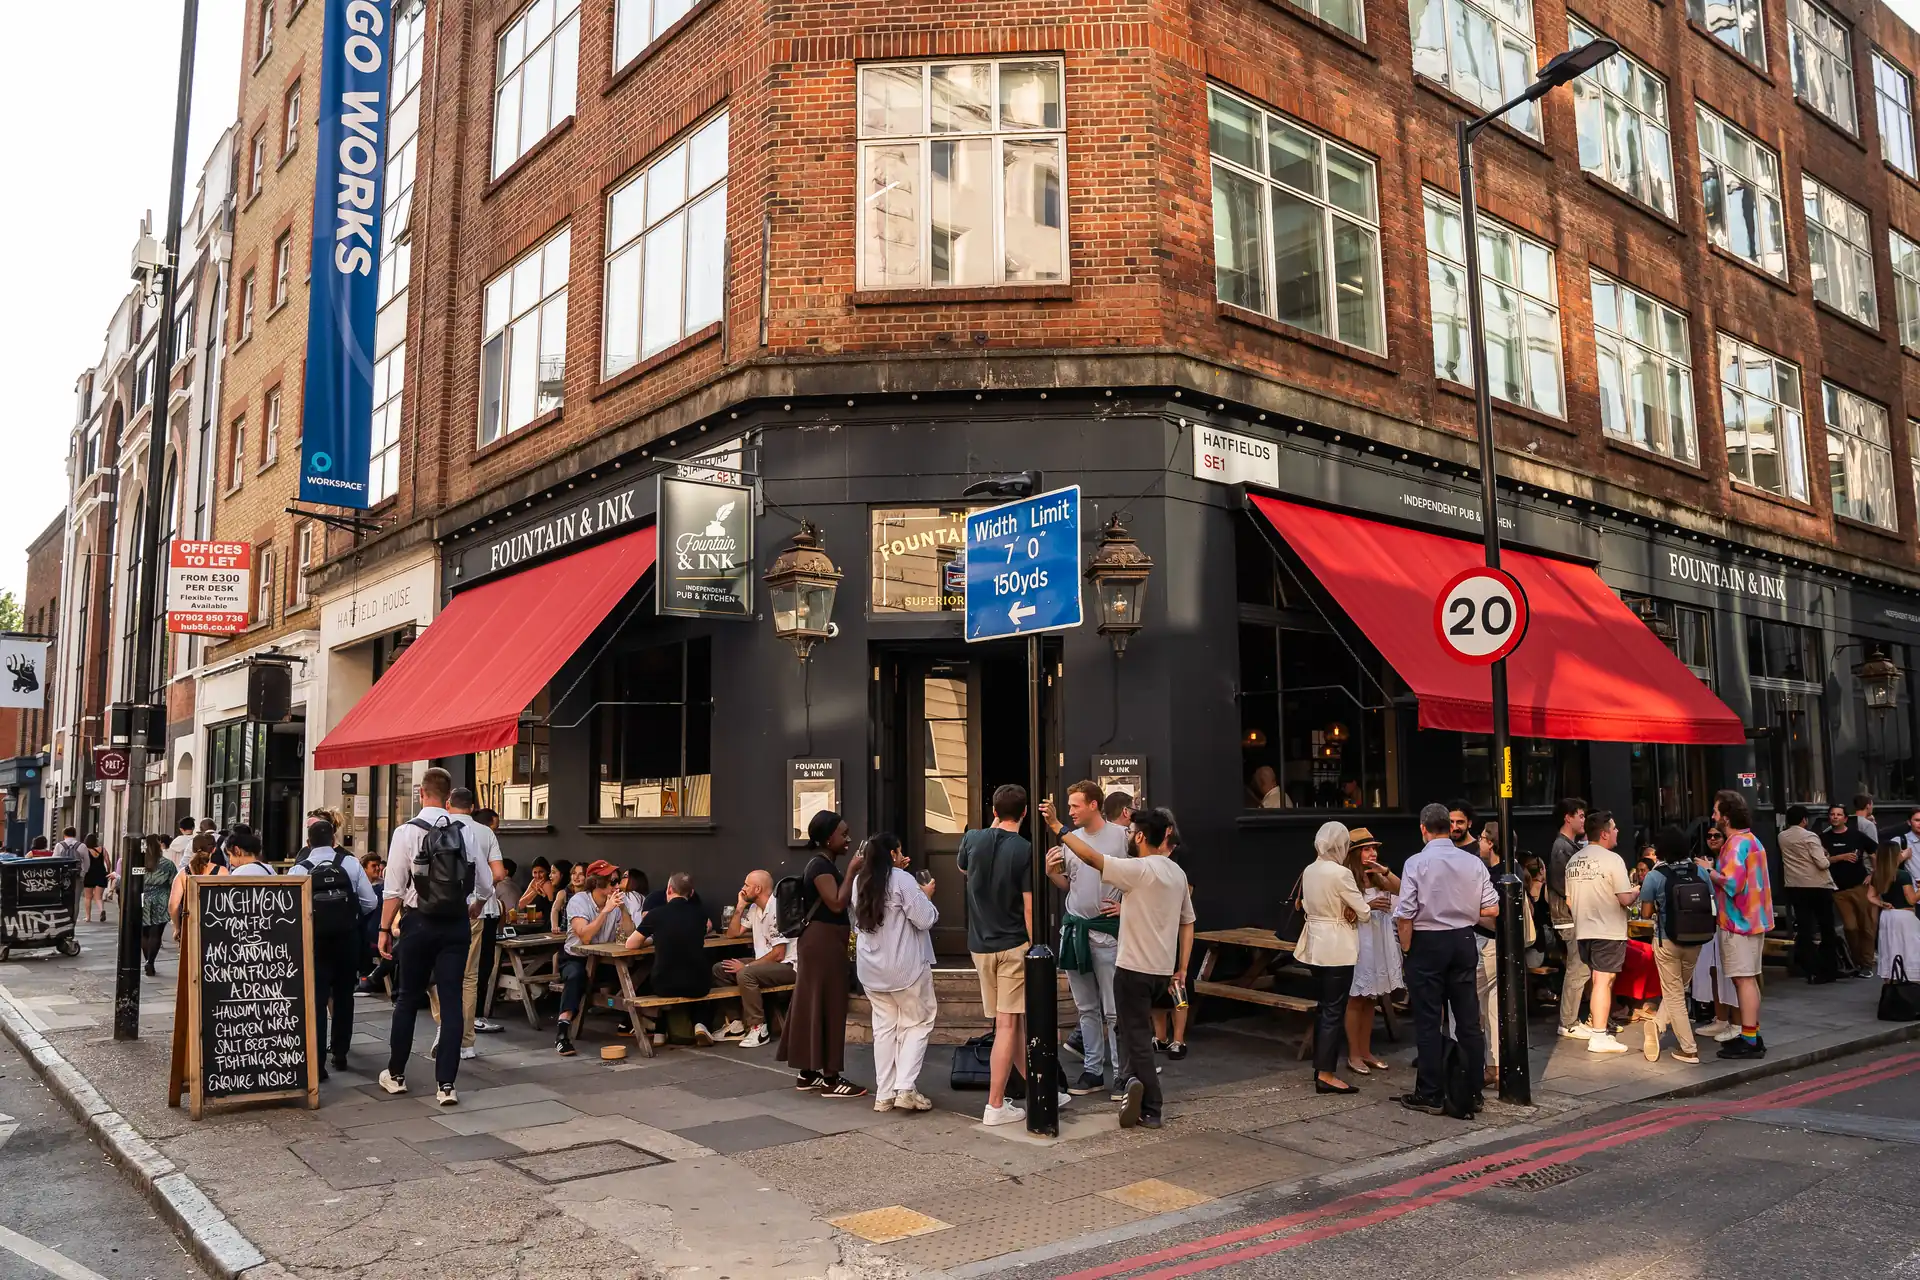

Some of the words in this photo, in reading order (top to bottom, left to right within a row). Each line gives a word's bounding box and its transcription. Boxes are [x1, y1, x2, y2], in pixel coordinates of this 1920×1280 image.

[344, 0, 384, 73] GO
[335, 91, 380, 277] WORKS
[1203, 432, 1270, 460] HATFIELDS
[1204, 454, 1225, 471] SE1
[307, 476, 363, 491] WORKSPACE
[950, 512, 967, 523] TH
[1403, 494, 1458, 517] INDEPENDENT
[1459, 507, 1475, 520] PUB
[1475, 511, 1481, 522] &
[491, 513, 576, 571] FOUNTAIN
[580, 507, 593, 537] &
[597, 489, 635, 531] INK
[974, 516, 1018, 542] Width
[1031, 498, 1070, 528] Limit
[180, 543, 243, 555] OFFICES
[676, 532, 736, 556] Fountain
[880, 527, 967, 561] FOUNTAI
[185, 555, 205, 566] TO
[209, 556, 237, 567] LET
[677, 553, 695, 570] &
[698, 553, 735, 570] INK
[212, 574, 240, 583] £300
[993, 567, 1048, 596] 150yds
[1668, 552, 1745, 592] FOUNTAIN
[1748, 572, 1759, 594] &
[1760, 575, 1786, 600] INK
[676, 591, 693, 599] PUB
[702, 593, 735, 603] KITCHEN
[685, 584, 727, 593] INDEPENDENT
[337, 600, 378, 630] HATFIELD
[382, 586, 411, 613] HOUSE
[904, 596, 965, 606] SUPERIOR
[174, 614, 203, 622] 07902
[205, 614, 223, 622] 950
[226, 614, 243, 622] 736
[1449, 596, 1512, 636] 20
[181, 623, 236, 632] hub56.co.uk
[105, 760, 120, 769] PRET
[205, 887, 251, 917] LUNCH
[253, 887, 294, 917] MENU
[225, 915, 272, 933] MON-FRI
[238, 930, 262, 943] 12-5
[206, 941, 227, 965] ANY
[229, 942, 292, 963] SANDWICH,
[247, 962, 285, 982] FRIES
[286, 962, 298, 978] &
[231, 982, 242, 999] A
[243, 981, 288, 1000] DRINK
[213, 1002, 261, 1020] HALLOUMI
[263, 1001, 291, 1017] WRAP
[215, 1020, 264, 1038] CHICKEN
[267, 1015, 299, 1031] WRAP
[215, 1039, 241, 1055] SALT
[245, 1037, 271, 1051] BEEF
[271, 1034, 301, 1050] SANDO
[215, 1053, 240, 1072] FISH
[240, 1051, 282, 1069] FINGER
[209, 1073, 254, 1091] ENQUIRE
[258, 1071, 298, 1087] INSIDE!
